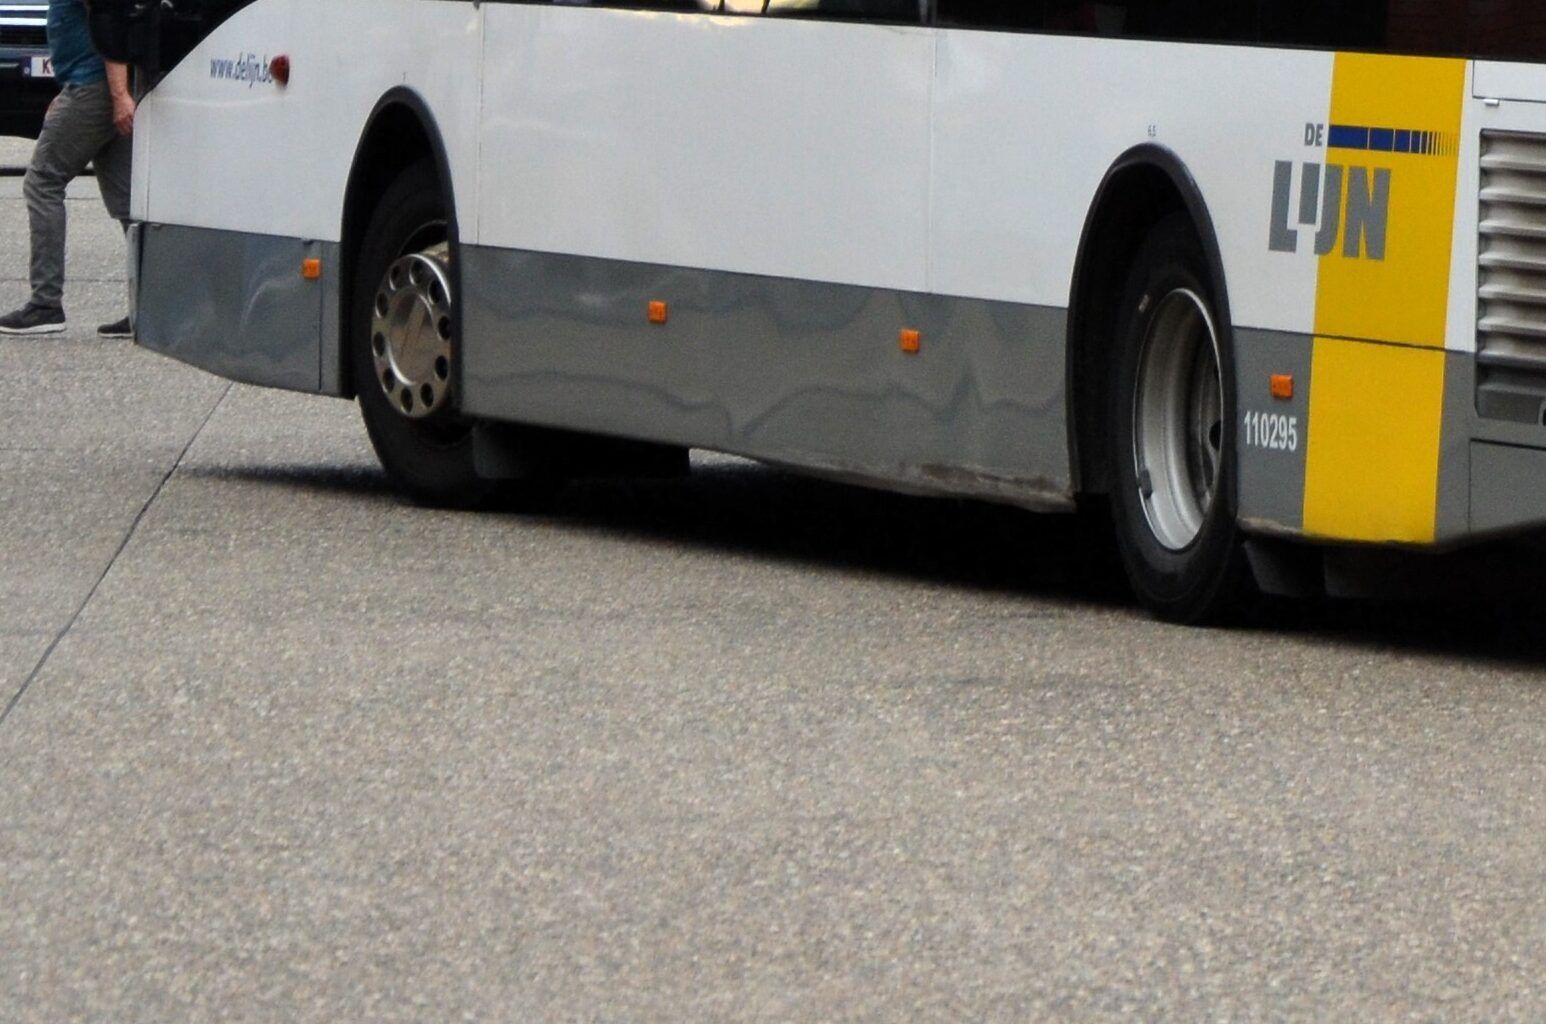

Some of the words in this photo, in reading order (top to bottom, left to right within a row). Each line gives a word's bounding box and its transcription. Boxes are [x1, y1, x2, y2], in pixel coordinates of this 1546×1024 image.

[1304, 123, 1324, 146] DE
[1268, 159, 1391, 261] LIJN
[1243, 411, 1298, 451] 110295
